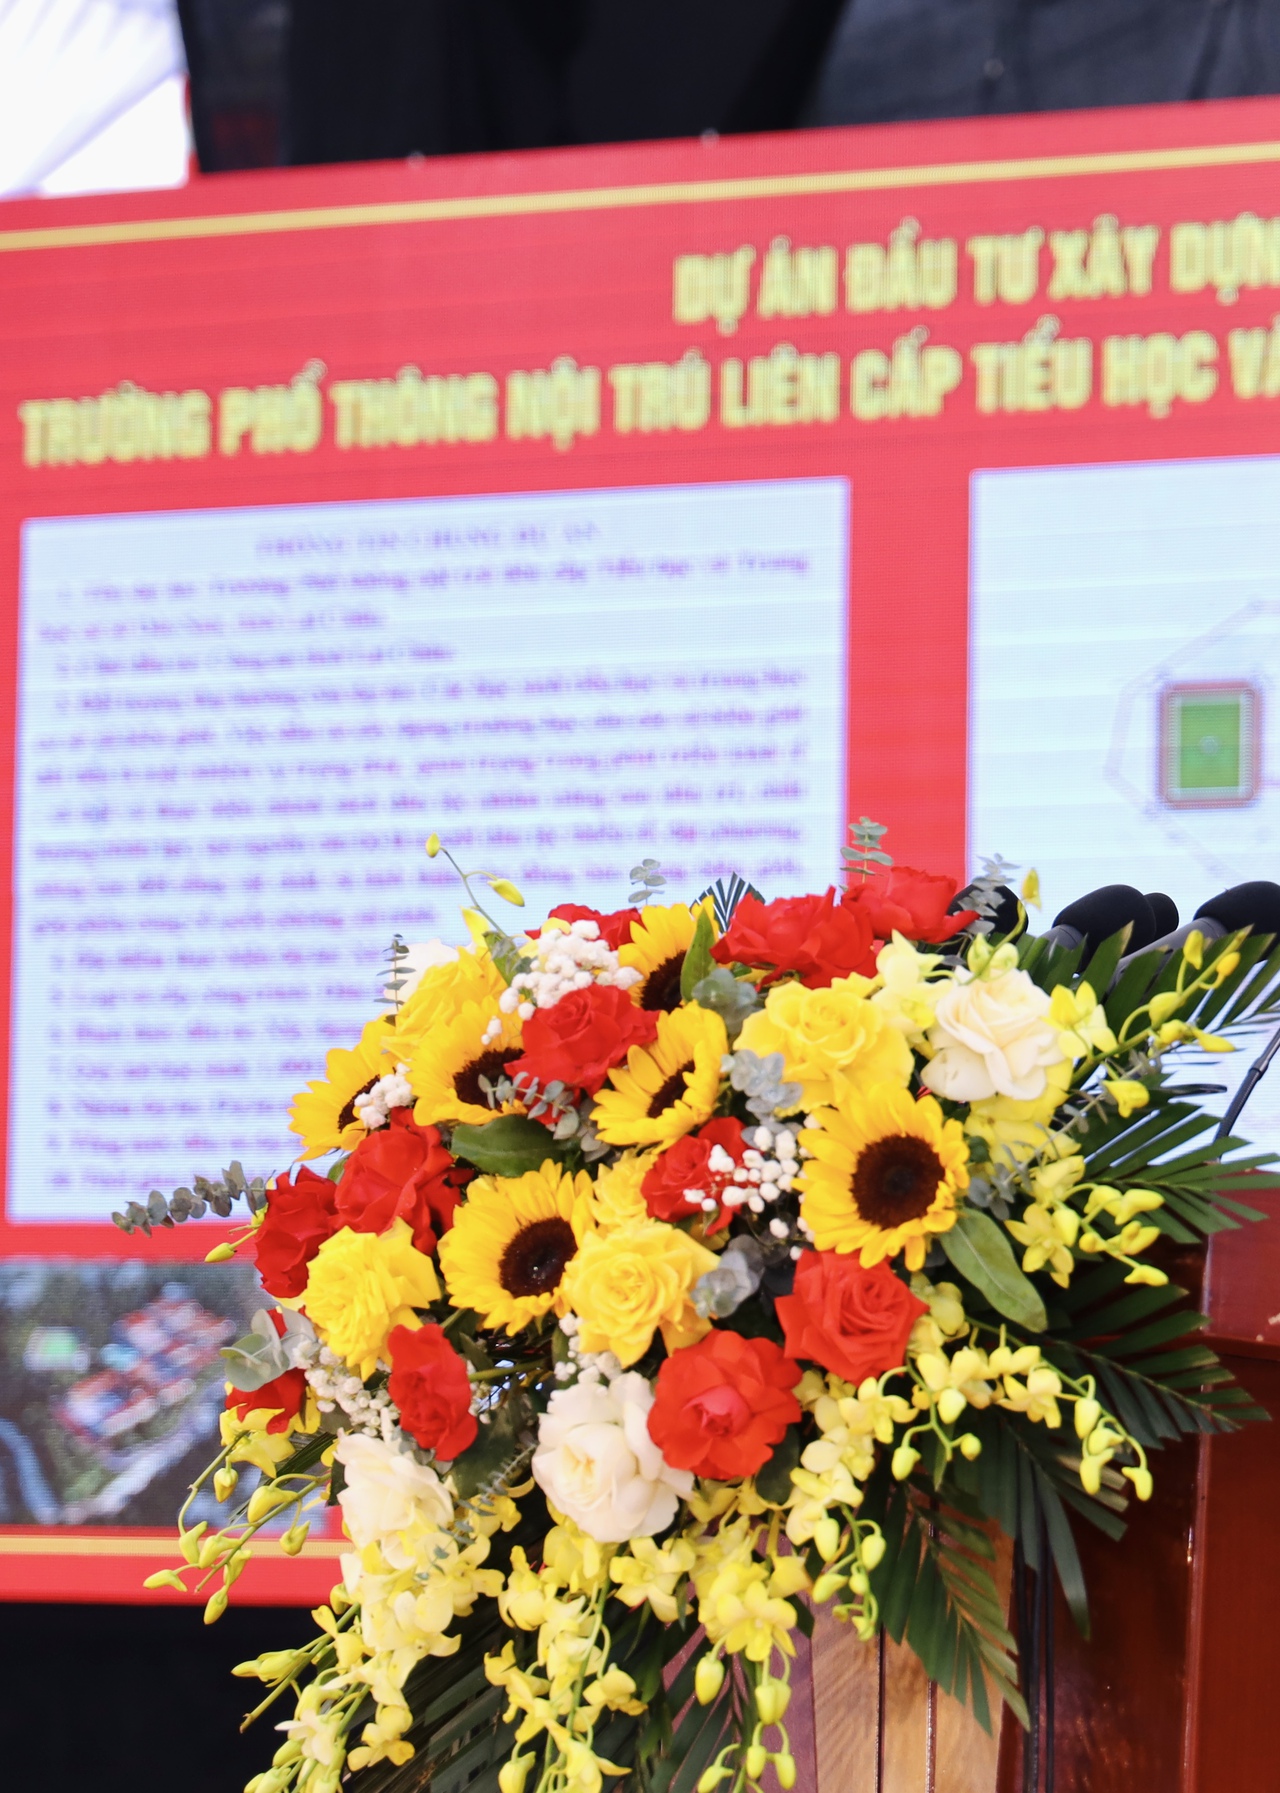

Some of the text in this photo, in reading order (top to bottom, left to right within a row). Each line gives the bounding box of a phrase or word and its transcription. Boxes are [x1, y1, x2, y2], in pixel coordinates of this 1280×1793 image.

[673, 244, 756, 335] DỰ
[758, 235, 838, 317] ÁN
[845, 216, 958, 313] ĐẦU
[966, 225, 1044, 304] TƯ
[1049, 214, 1159, 300] XÂY
[18, 381, 212, 467] TRƯỜNG
[219, 357, 328, 458] PHỔ
[330, 363, 497, 449] THÔNG
[506, 353, 601, 452] NỘI
[608, 345, 712, 435] TRÚ
[720, 341, 840, 429] LIÊN
[851, 325, 962, 421] CẤP
[970, 313, 1094, 415] TIỂU
[1103, 330, 1219, 419] HỌC
